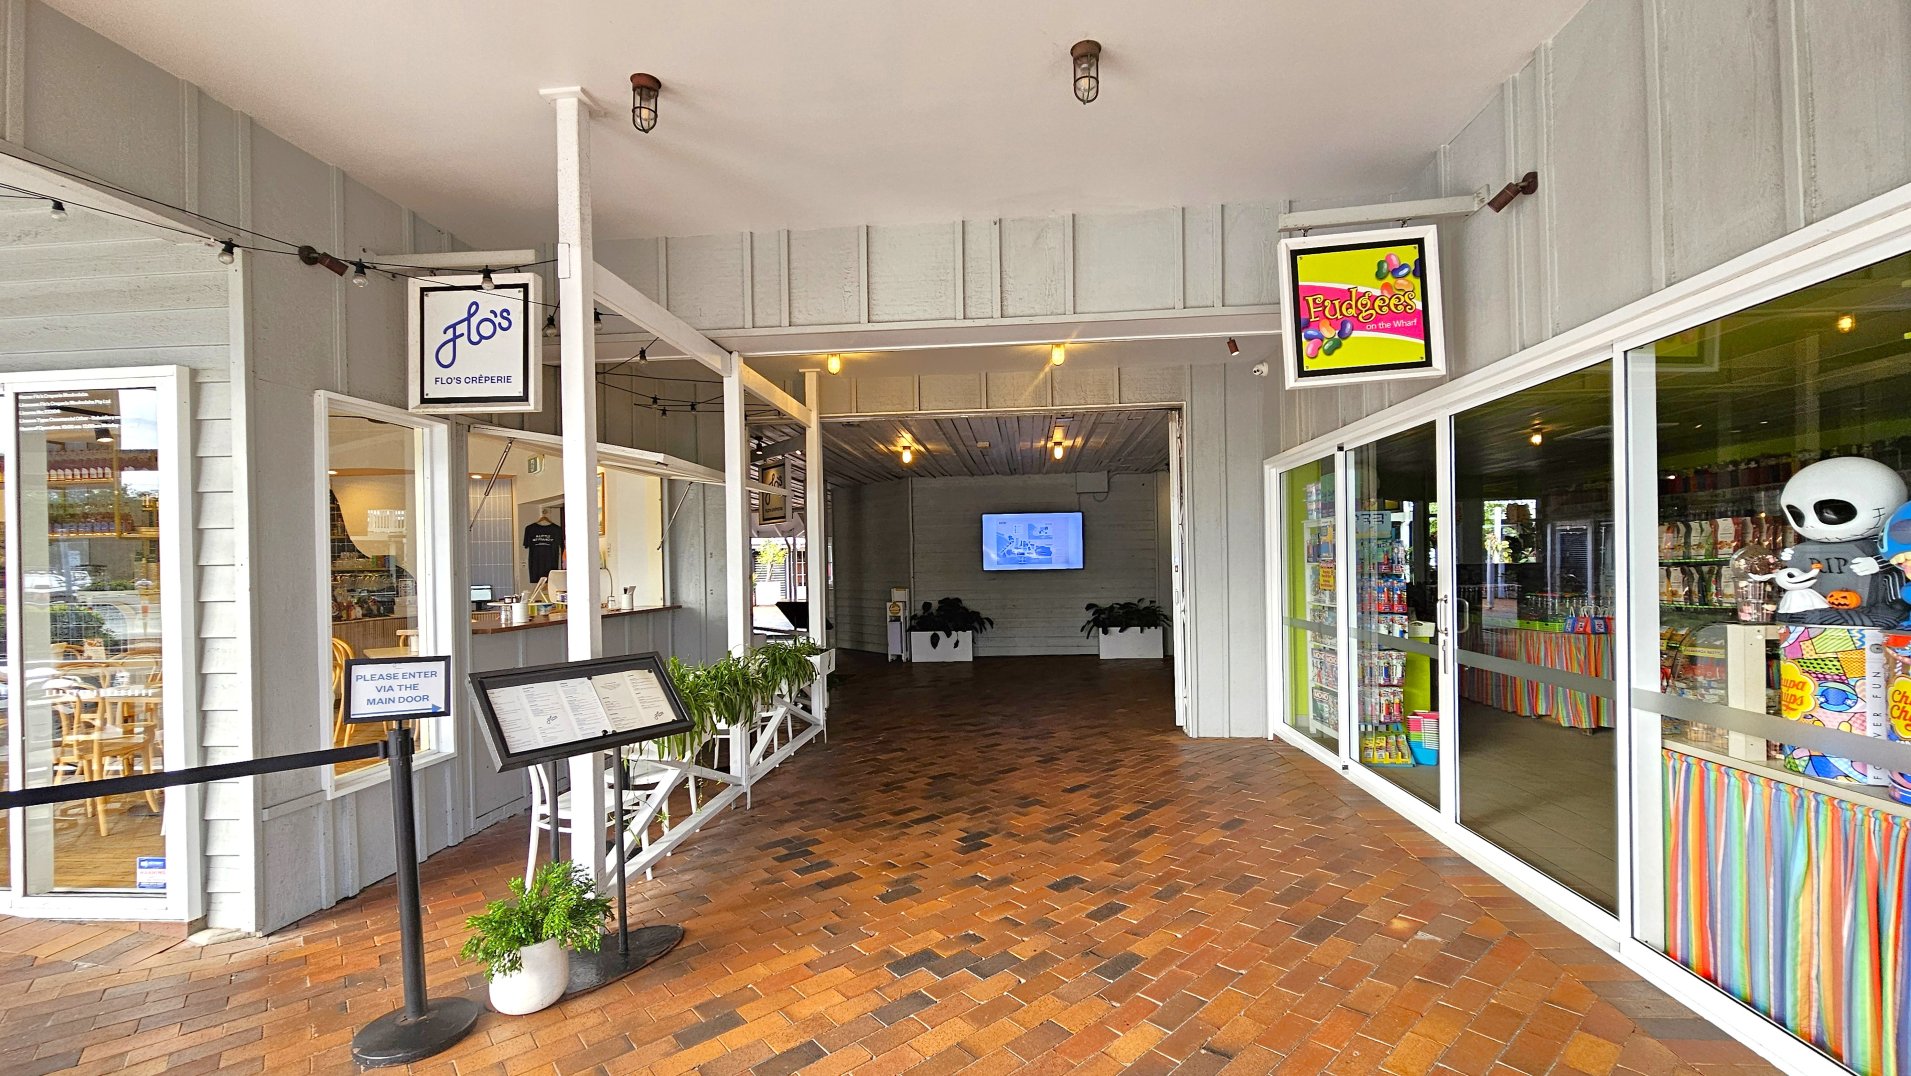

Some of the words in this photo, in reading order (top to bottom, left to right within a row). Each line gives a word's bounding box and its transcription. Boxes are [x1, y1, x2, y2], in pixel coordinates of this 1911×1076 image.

[1304, 286, 1416, 322] Fudgees
[1378, 321, 1391, 329] the
[1392, 318, 1418, 328] Wharf
[434, 300, 513, 369] Flo's
[434, 376, 462, 385] FLO'S
[464, 374, 513, 384] CRÊPERIE
[355, 672, 400, 682] PLEASE
[401, 670, 438, 680] ENTER
[375, 685, 395, 693] VIA
[396, 683, 420, 692] THE
[366, 697, 396, 706] MAIN
[397, 694, 430, 704] DOOR
